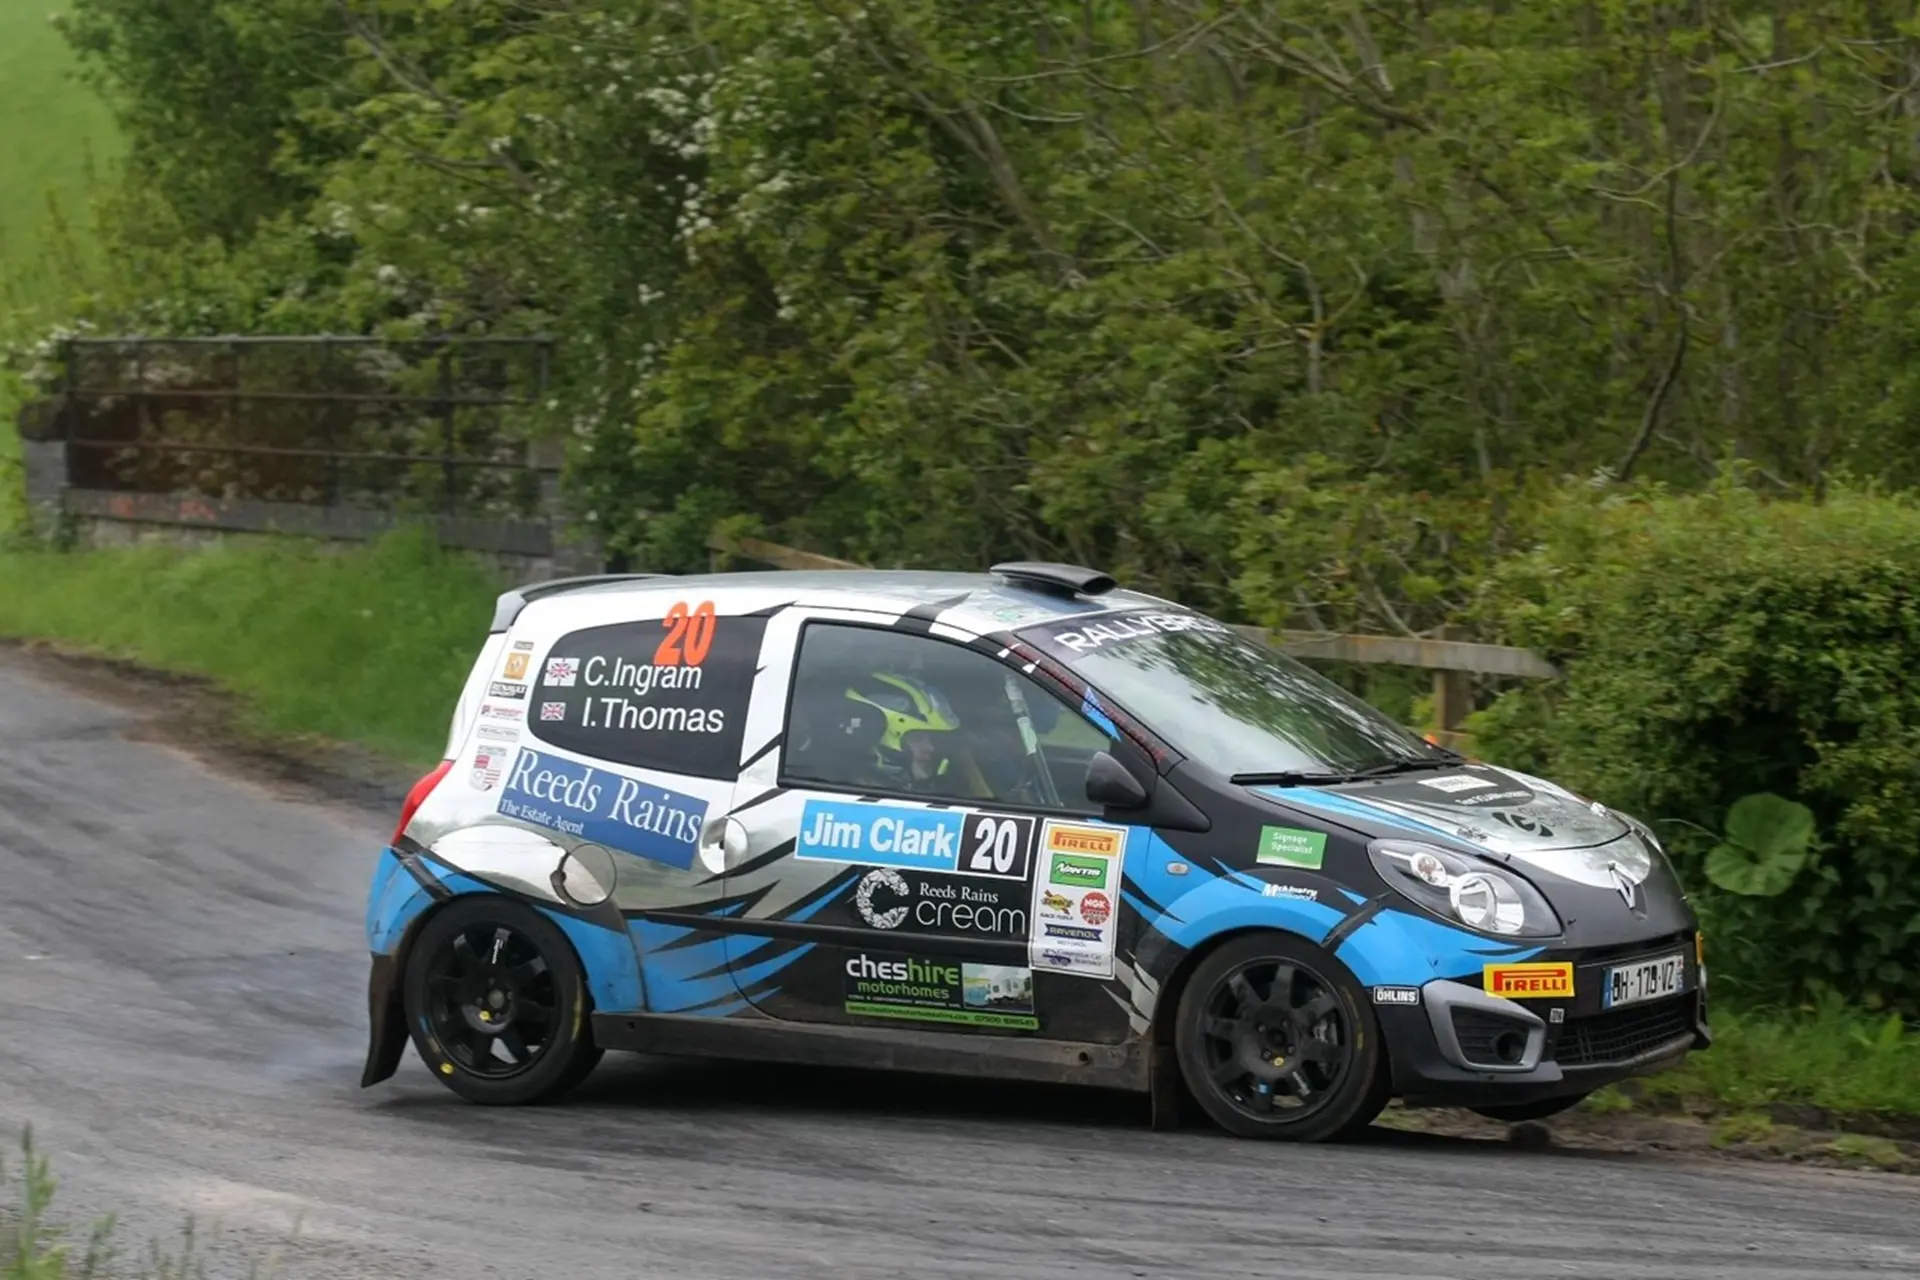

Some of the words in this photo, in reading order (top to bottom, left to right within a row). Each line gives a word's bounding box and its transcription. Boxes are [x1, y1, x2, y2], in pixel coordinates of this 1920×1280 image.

[654, 600, 716, 666] 20
[584, 656, 702, 695] C.Ingram
[582, 697, 725, 733] I.Thomas
[507, 748, 602, 813] Reeds
[607, 778, 702, 844] Rains
[500, 799, 520, 815] The
[520, 805, 553, 825] Estate
[551, 815, 585, 835] Agent
[803, 811, 861, 849] Jim
[869, 817, 957, 857] Clark
[969, 817, 1018, 873] 20
[1053, 831, 1114, 852] PIRELLI
[1271, 841, 1314, 854] Specialist
[1272, 832, 1308, 845] Signage
[919, 882, 957, 900] Reeds
[961, 886, 999, 904] Rains
[1084, 899, 1107, 910] NGK
[915, 900, 1026, 936] cream
[1049, 926, 1099, 940] RAVENOL
[845, 954, 960, 986] cheshire
[1493, 969, 1567, 992] PIRELLI
[857, 980, 951, 1000] motorhomes
[1376, 989, 1416, 1003] ÖHLINS
